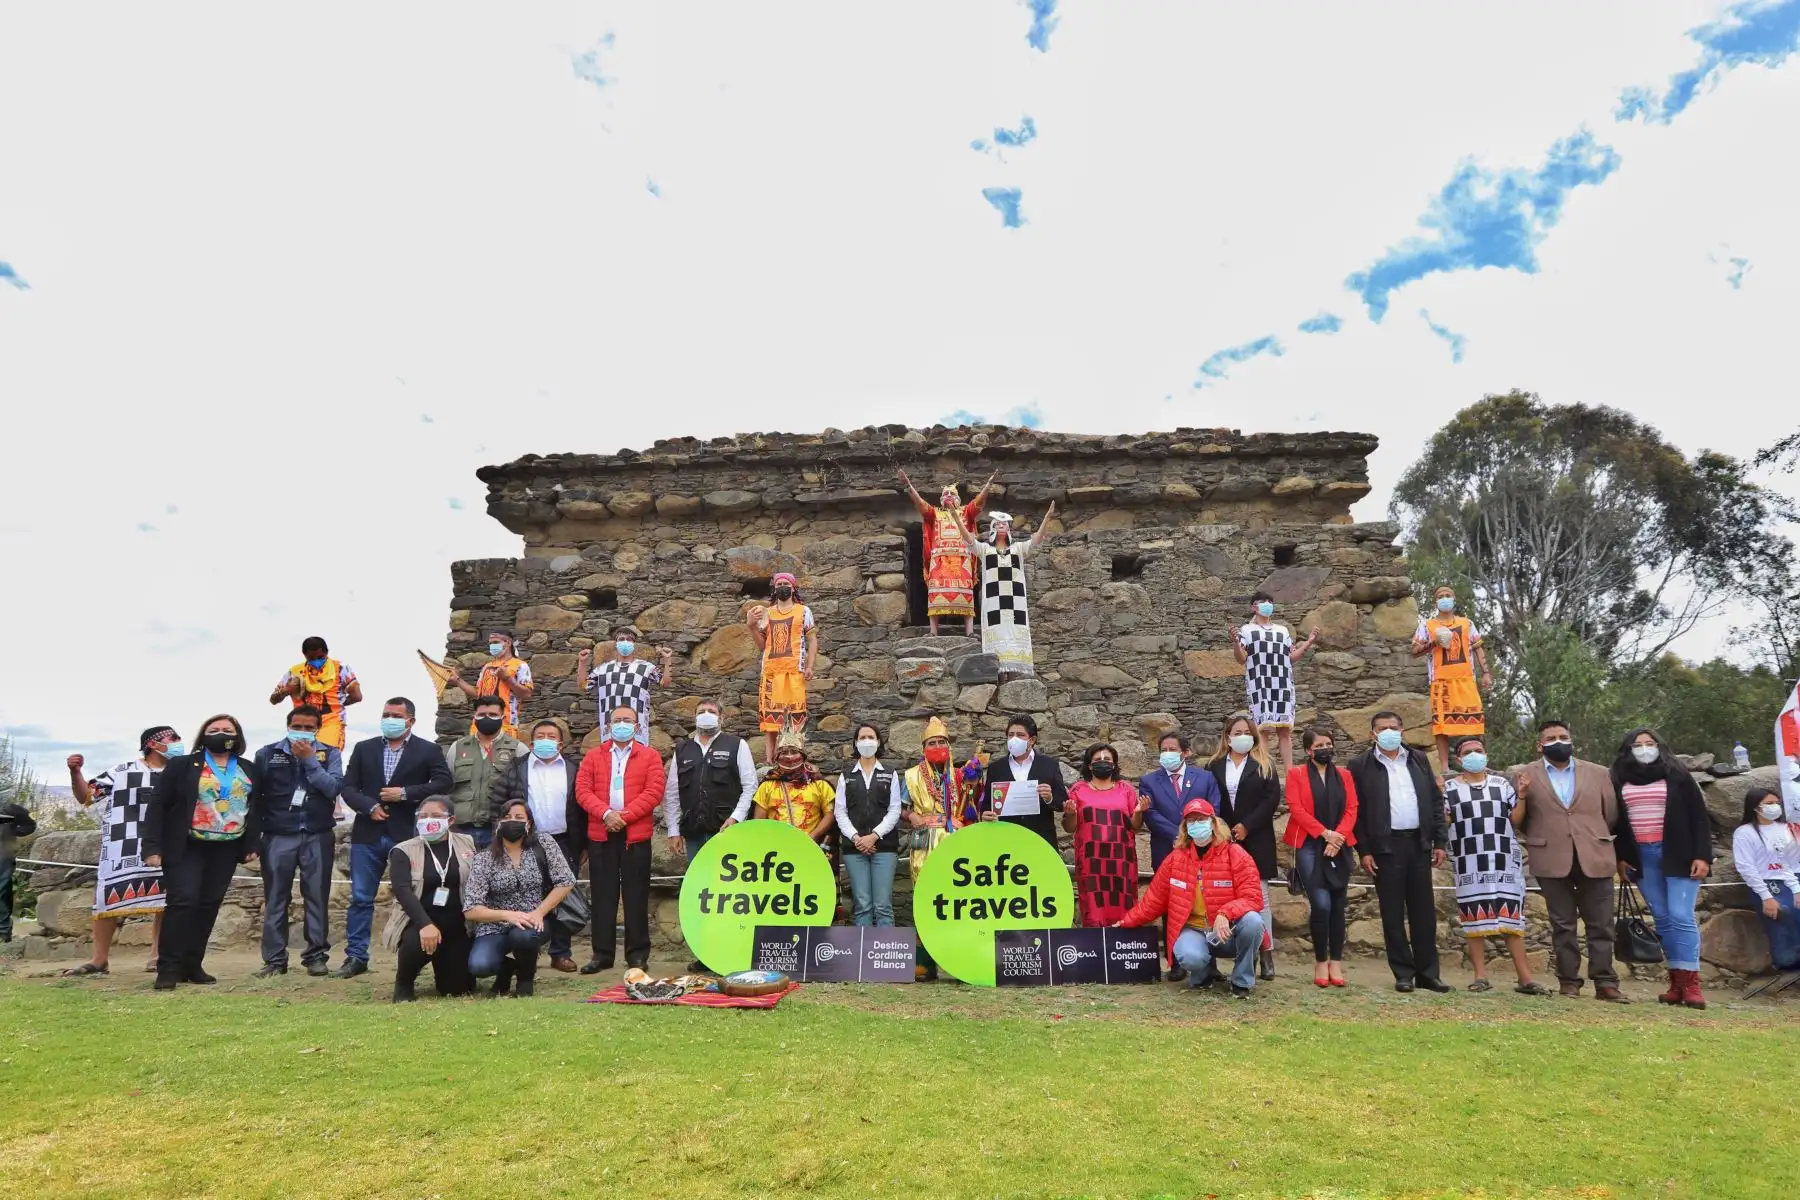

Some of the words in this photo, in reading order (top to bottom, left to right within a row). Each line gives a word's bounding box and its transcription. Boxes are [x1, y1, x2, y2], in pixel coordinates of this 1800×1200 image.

[720, 852, 794, 883] Safe
[953, 854, 1030, 886] Safe
[699, 884, 818, 916] travels
[933, 886, 1057, 920] travels
[760, 942, 792, 950] WORLD
[873, 941, 910, 950] Destino
[1002, 946, 1035, 954] WORLD
[1115, 941, 1148, 950] Destino
[759, 949, 790, 957] TRAVEL
[791, 949, 798, 957] &
[867, 951, 913, 960] Cordillera
[1002, 953, 1034, 962] TRAVEL
[1035, 953, 1042, 961] &
[1110, 950, 1158, 961] Conchucos
[759, 956, 798, 964] TOURISM
[873, 960, 906, 969] Blanca
[1002, 960, 1042, 969] TOURISM
[758, 963, 798, 972] COUNCIL
[1124, 960, 1140, 970] Sur
[1003, 968, 1043, 976] COUNCIL
